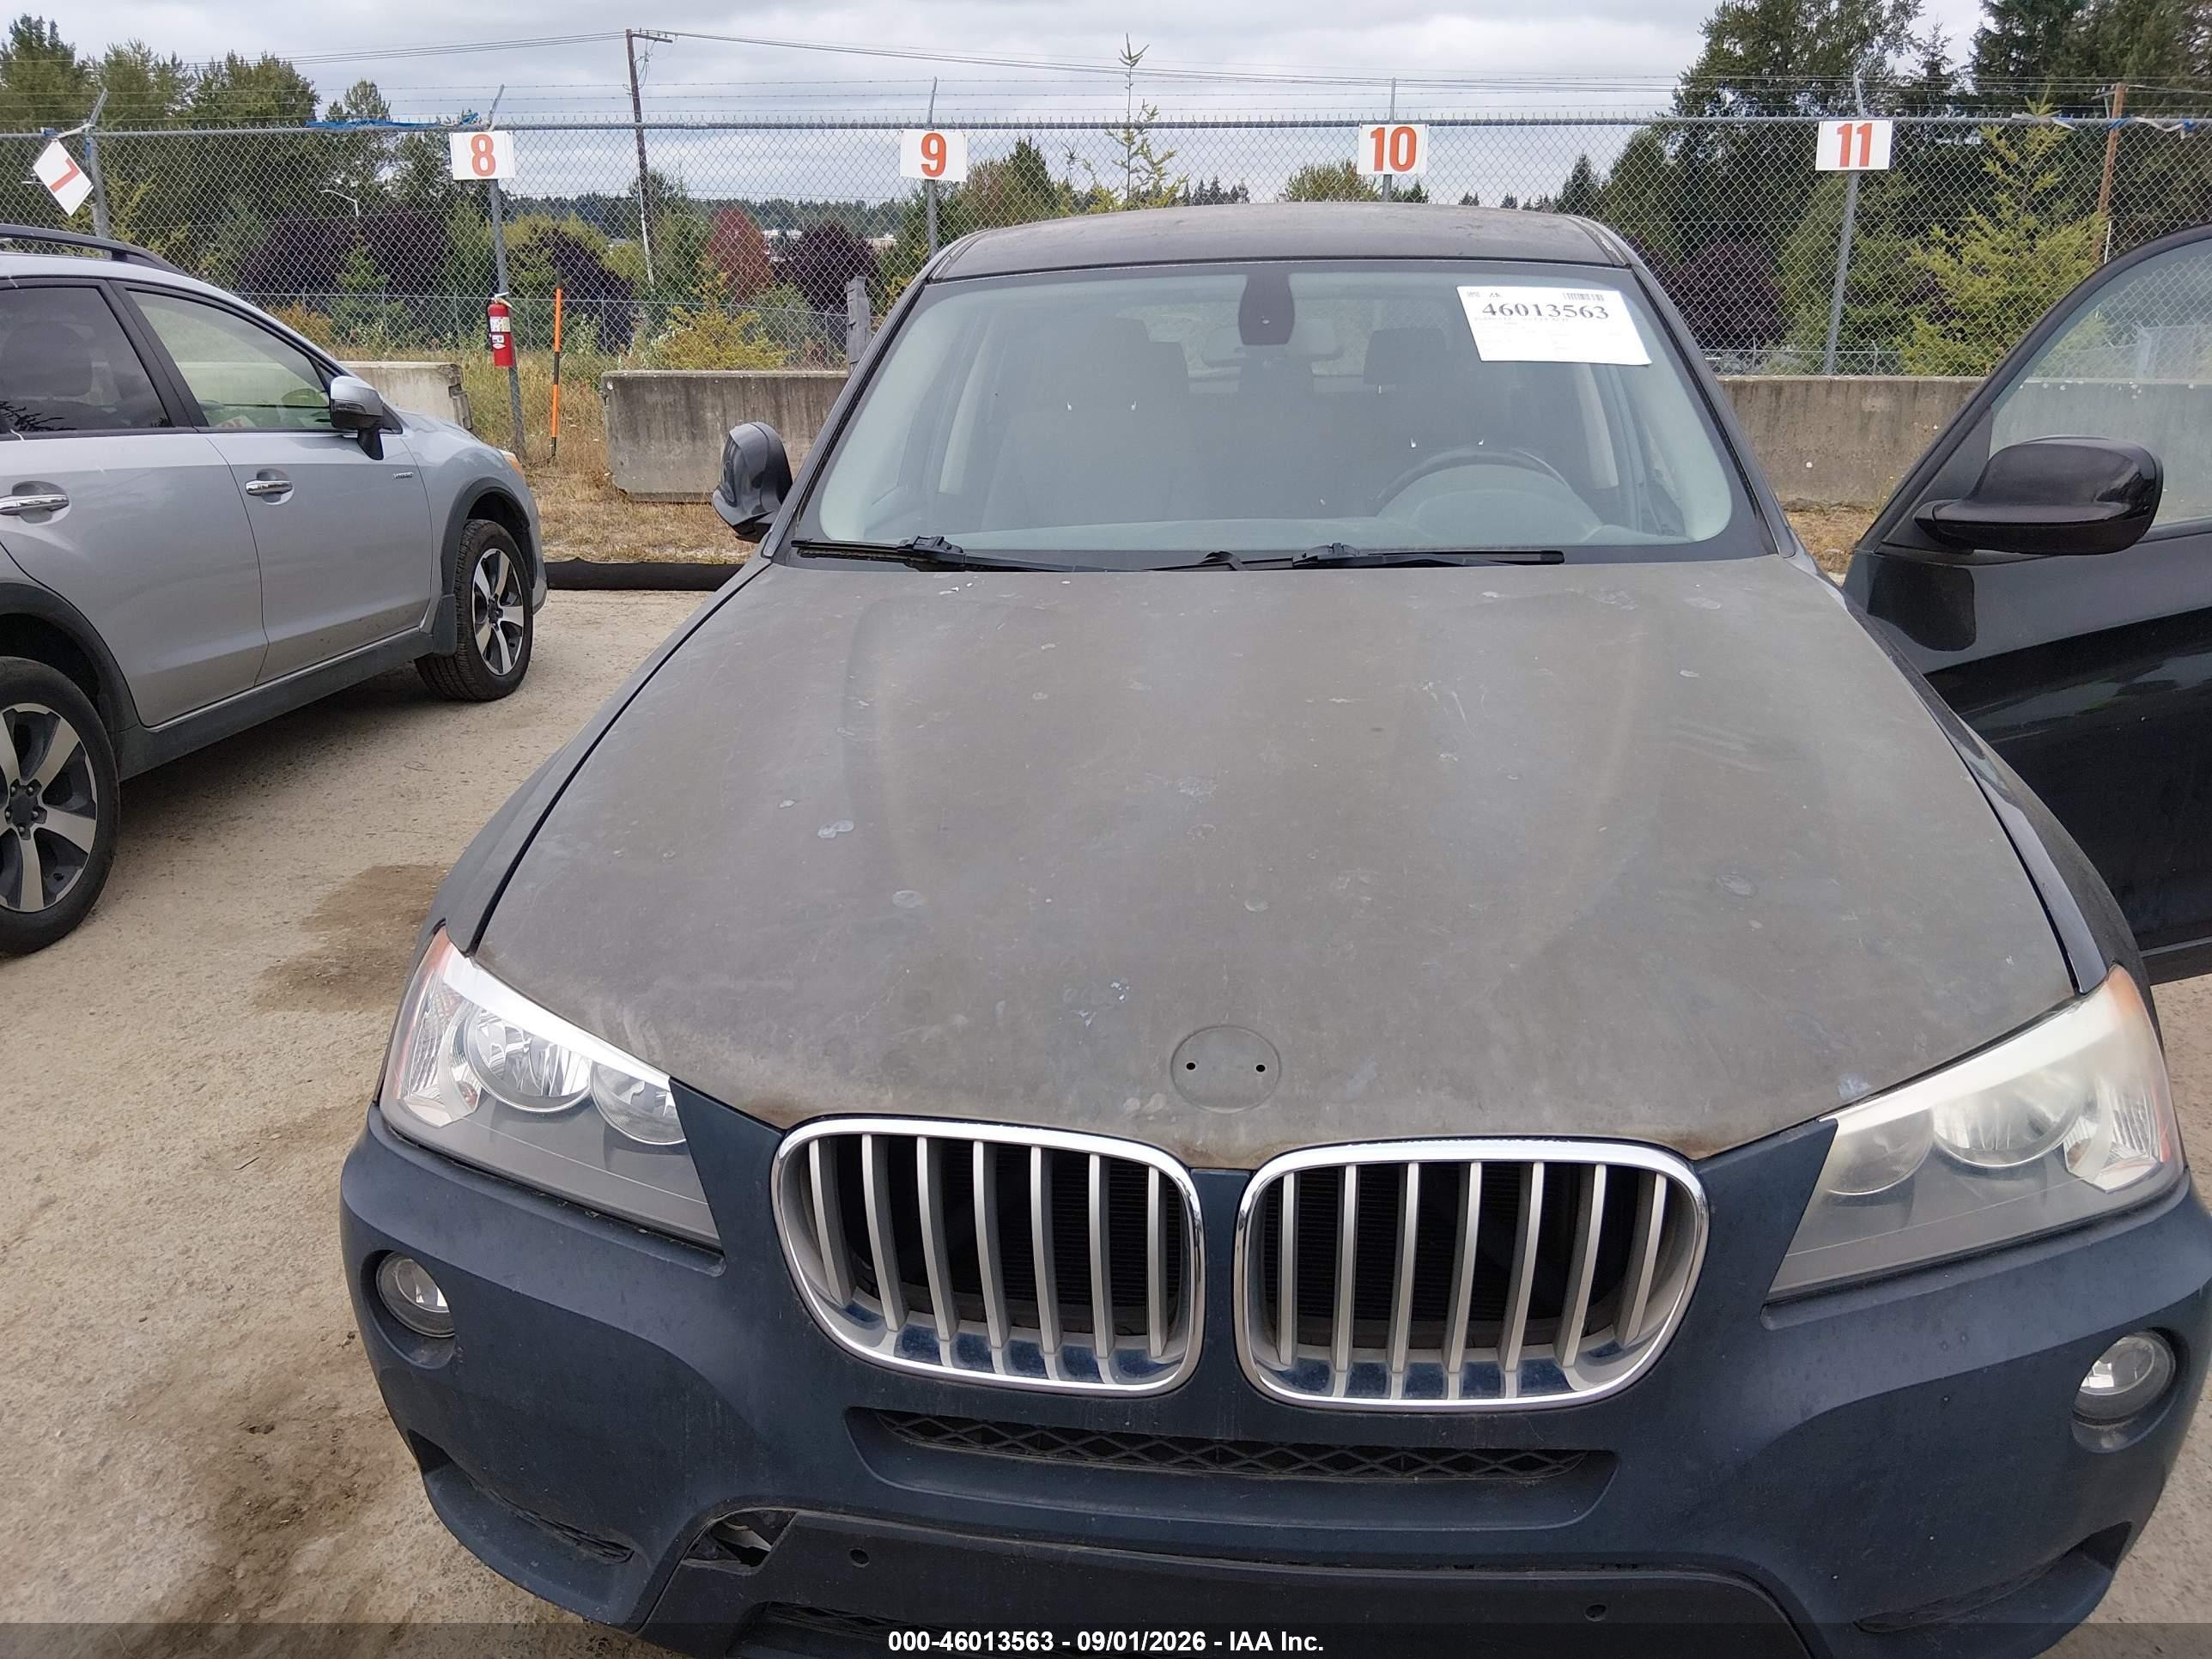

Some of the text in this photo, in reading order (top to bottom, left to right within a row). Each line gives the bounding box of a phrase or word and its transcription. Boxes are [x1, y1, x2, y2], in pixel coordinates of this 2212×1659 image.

[471, 133, 496, 177] 8
[921, 132, 947, 178] 9
[1370, 125, 1417, 173] 10
[1837, 122, 1873, 167] 11
[1482, 301, 1609, 320] 46013563
